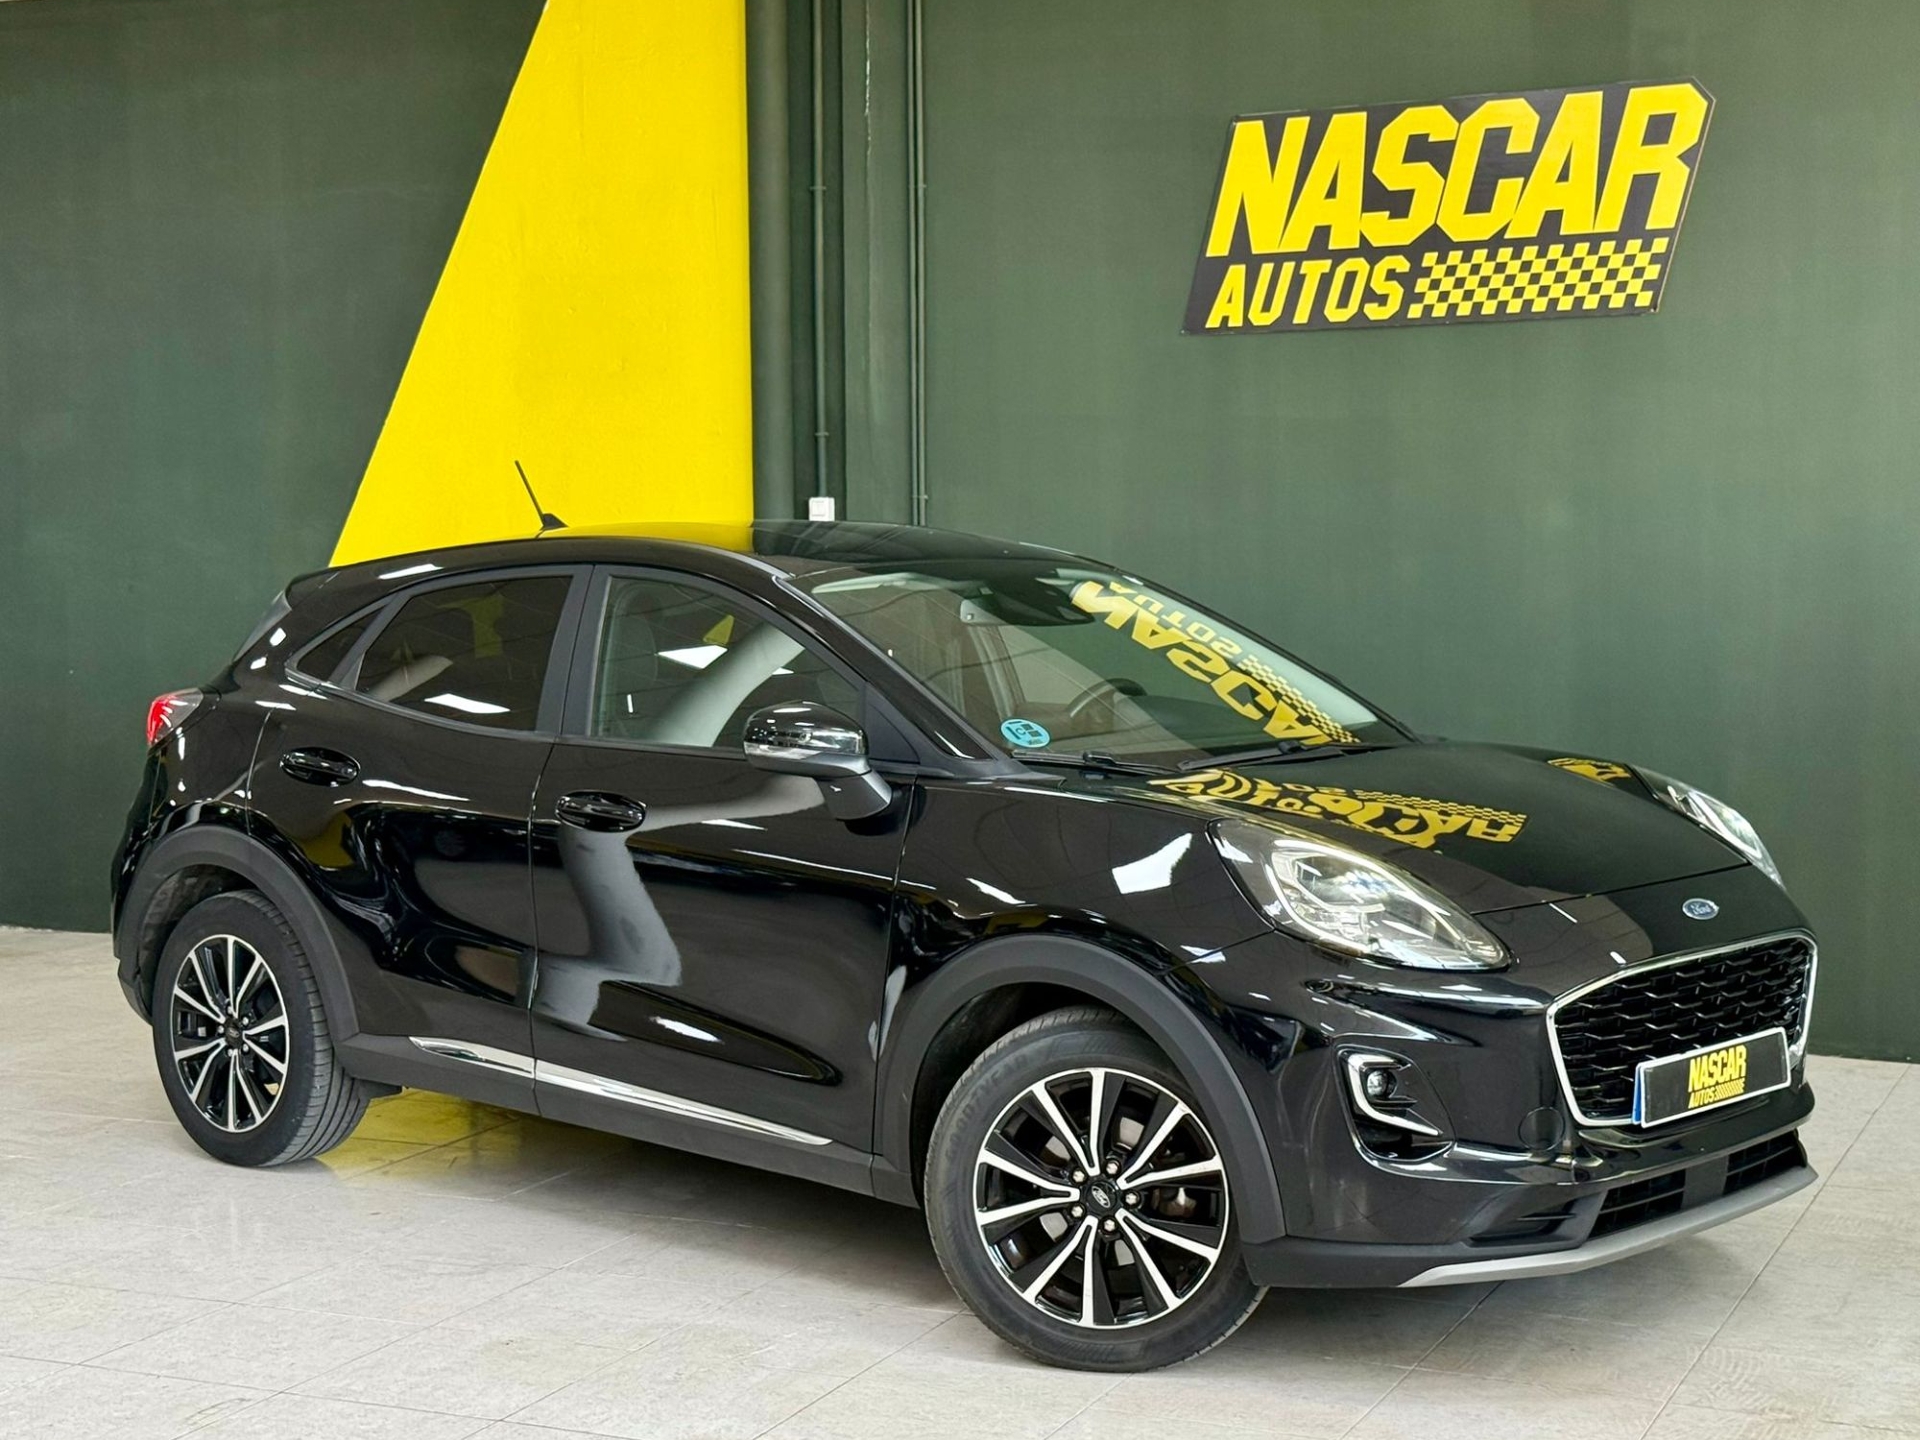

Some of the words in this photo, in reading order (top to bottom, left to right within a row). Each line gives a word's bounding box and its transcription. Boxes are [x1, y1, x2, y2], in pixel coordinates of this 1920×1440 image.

[1205, 83, 1708, 256] NASCAR
[1205, 254, 1411, 328] AUTOS
[1688, 1044, 1747, 1093] NASCAR
[1688, 1087, 1716, 1109] AUTOS
